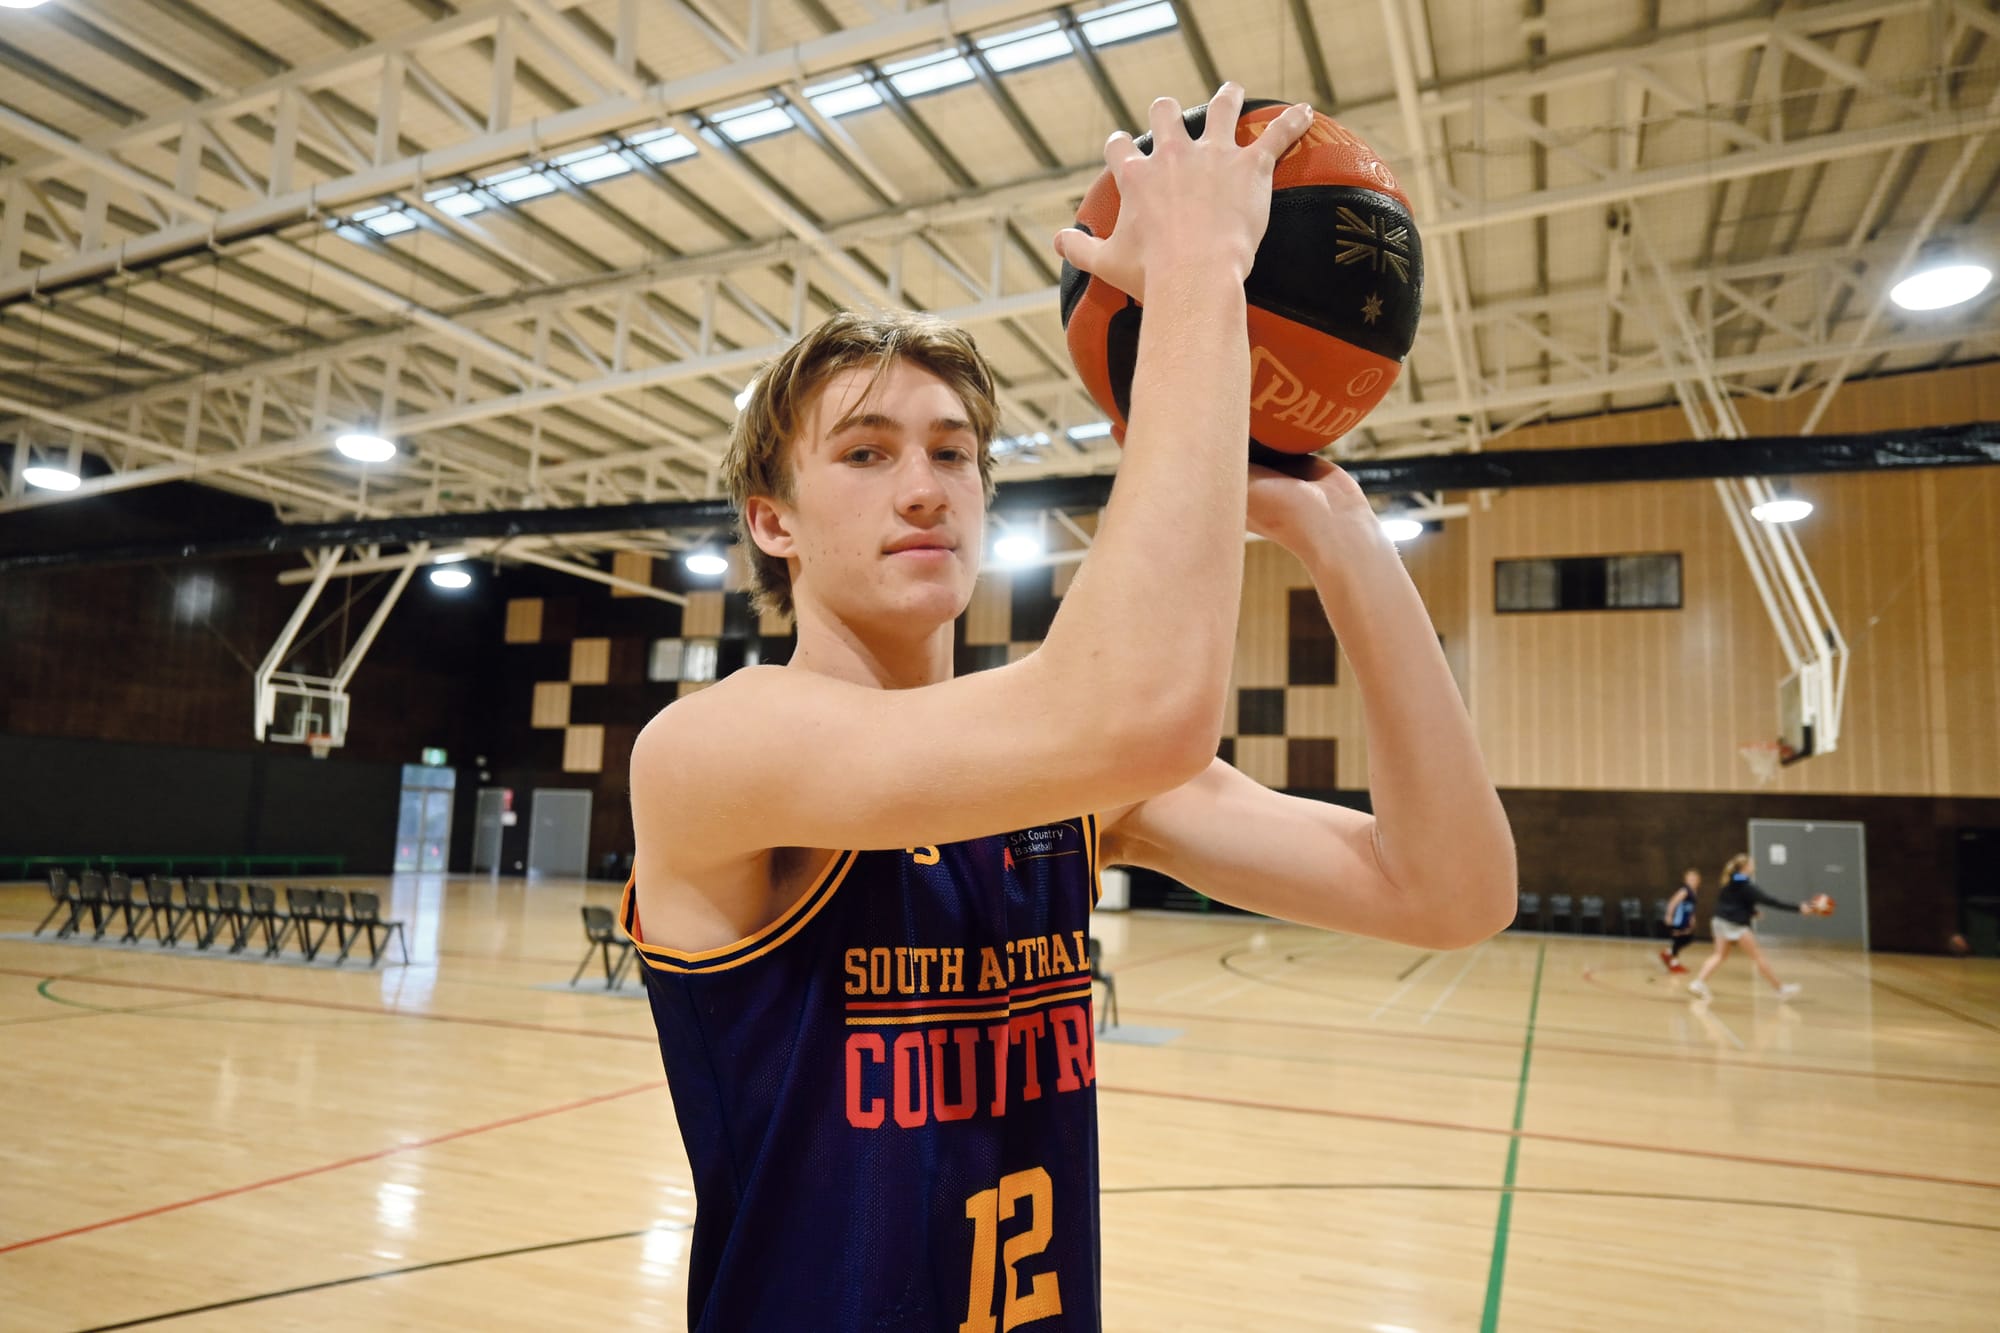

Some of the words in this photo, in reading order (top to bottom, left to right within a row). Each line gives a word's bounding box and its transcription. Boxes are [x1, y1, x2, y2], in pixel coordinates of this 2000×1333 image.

[1010, 832, 1028, 846] SA
[1028, 829, 1064, 841] Country
[845, 947, 964, 995] SOUTH
[958, 1166, 1063, 1333] 12
